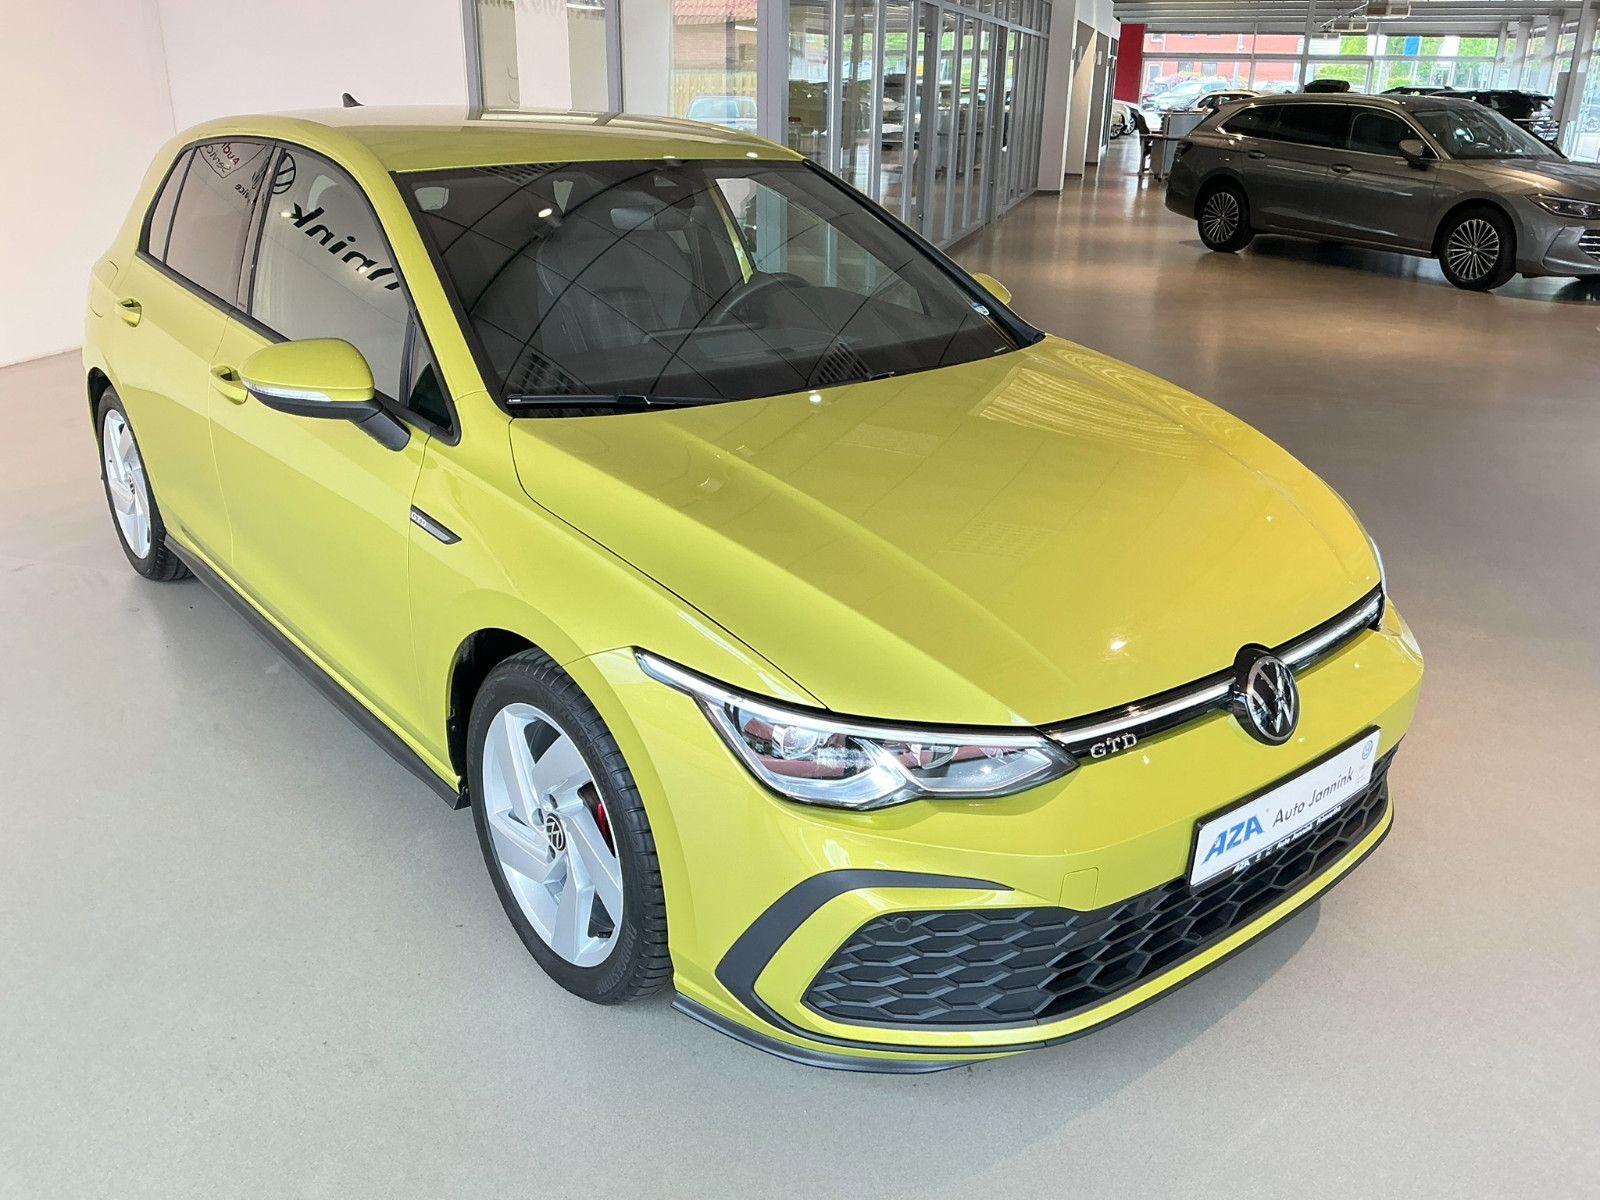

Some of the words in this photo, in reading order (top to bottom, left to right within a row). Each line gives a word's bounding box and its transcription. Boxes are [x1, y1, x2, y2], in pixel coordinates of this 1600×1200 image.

[1091, 733, 1137, 758] GTD
[1202, 815, 1264, 865] AZA
[1272, 802, 1305, 827] Auto
[1309, 766, 1354, 807] Jannink
